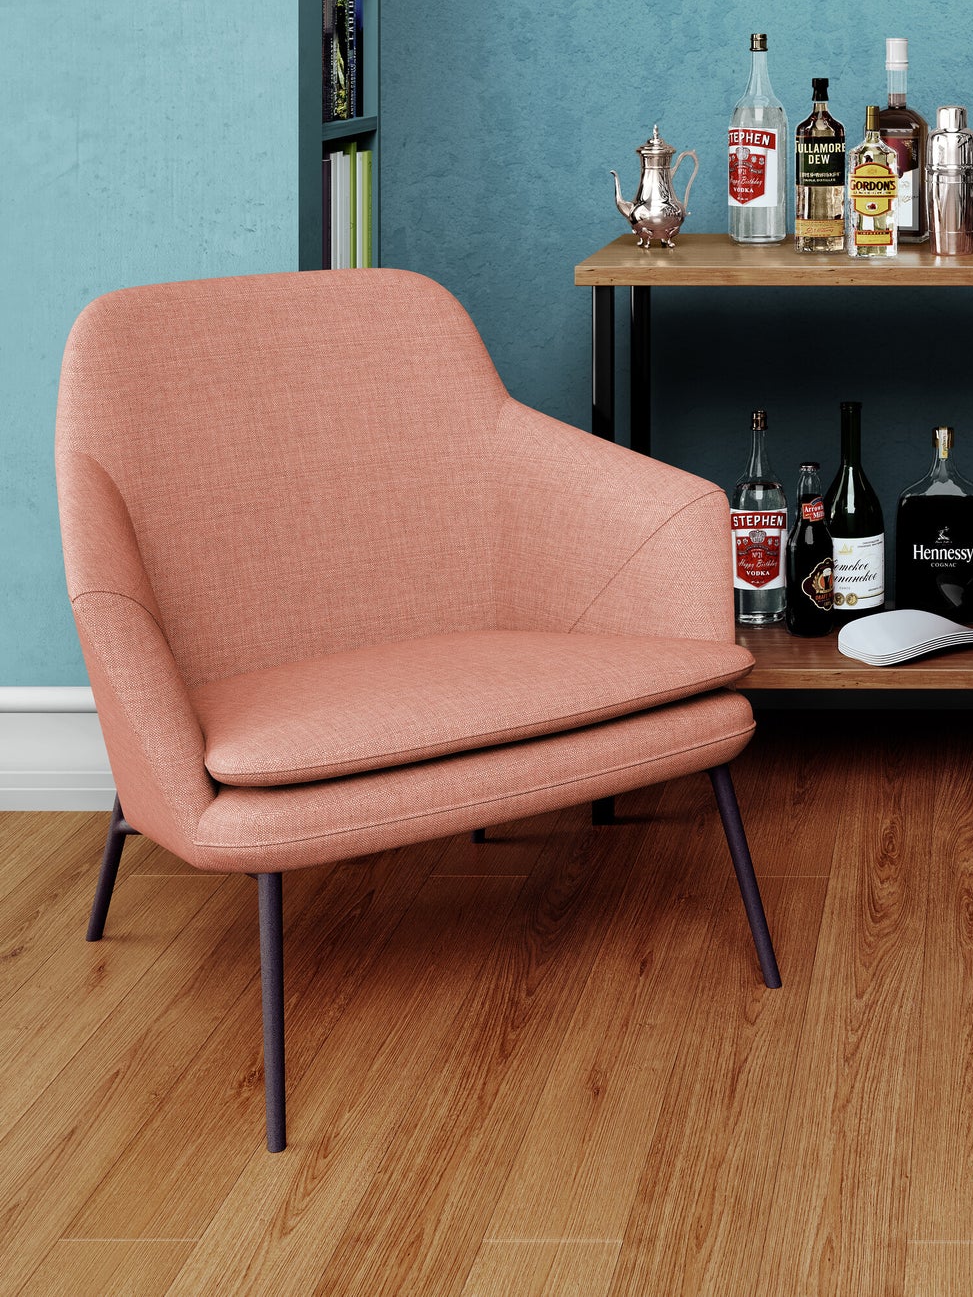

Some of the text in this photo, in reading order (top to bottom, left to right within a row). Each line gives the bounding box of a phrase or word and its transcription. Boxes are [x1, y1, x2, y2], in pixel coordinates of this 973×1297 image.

[729, 132, 770, 146] TEPHEN
[796, 141, 846, 154] TULLAMORE
[808, 154, 830, 164] DEW
[850, 179, 896, 191] GORDON'S
[733, 515, 783, 526] STEPHEN
[913, 544, 973, 562] Hennessy
